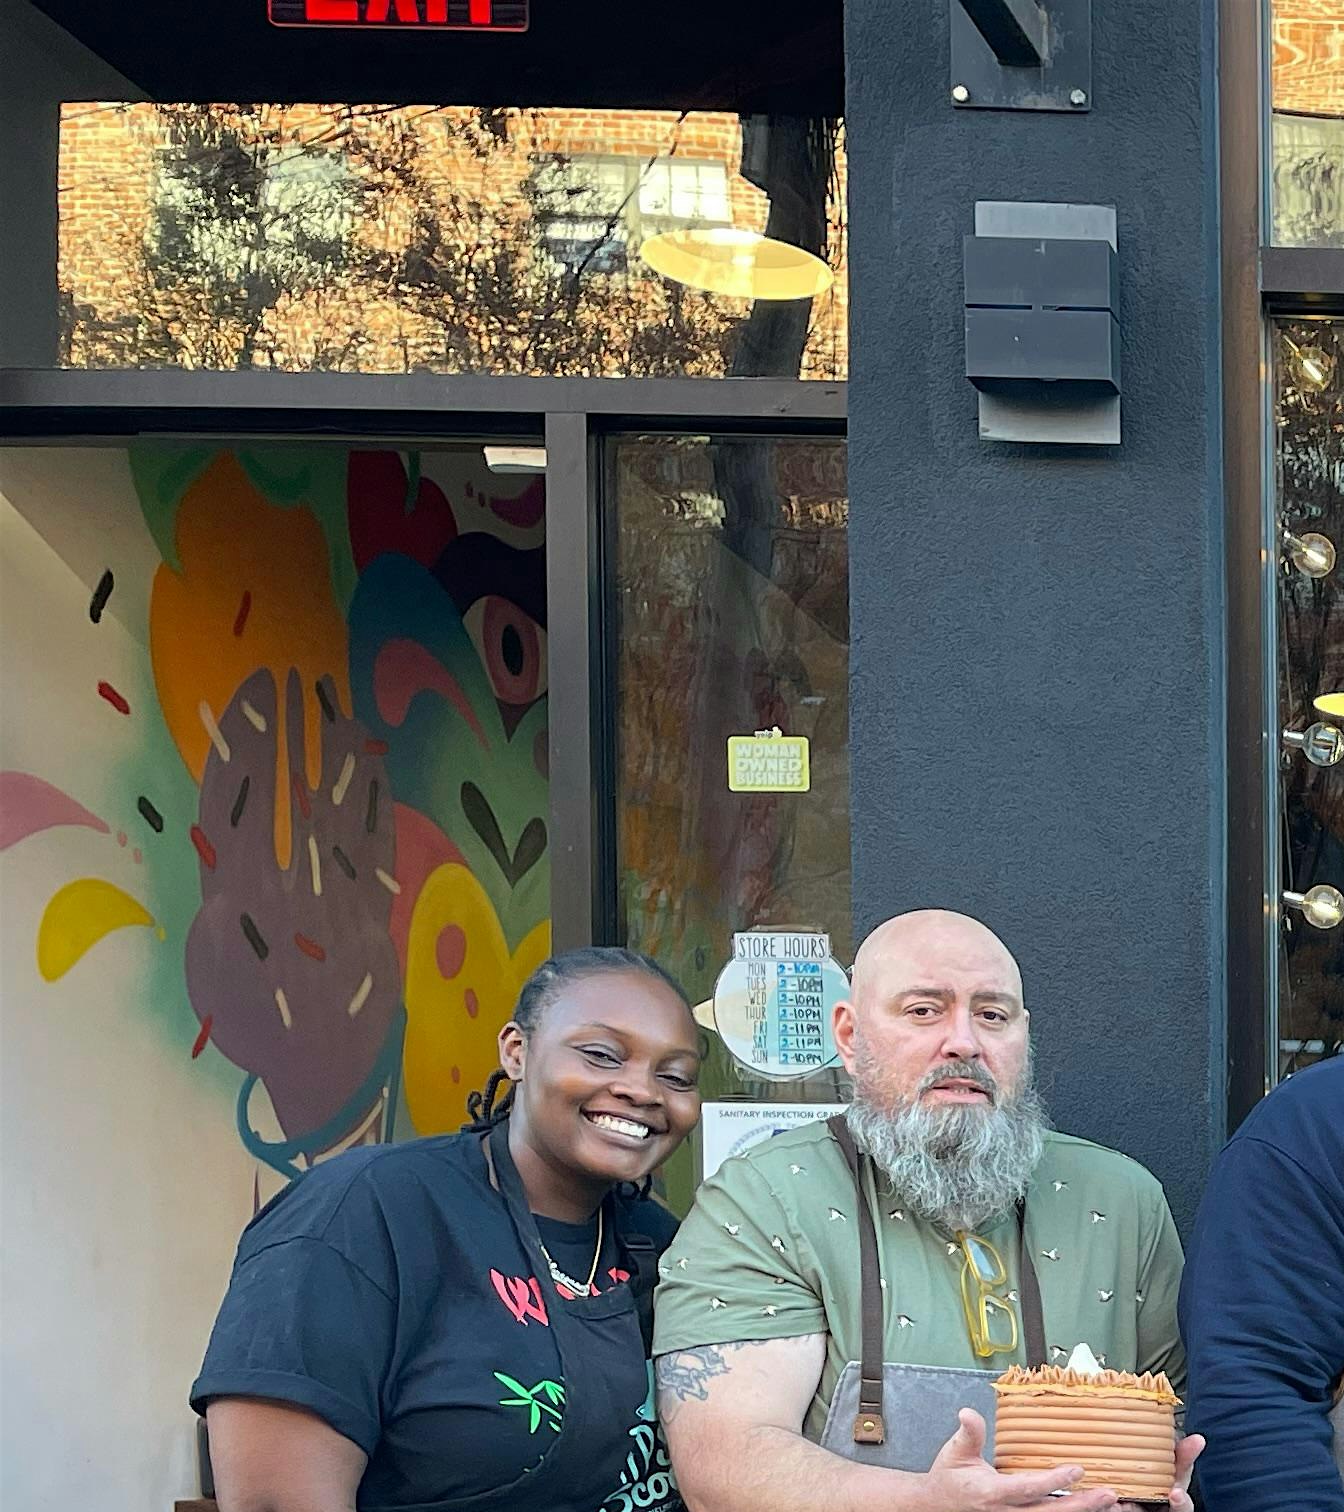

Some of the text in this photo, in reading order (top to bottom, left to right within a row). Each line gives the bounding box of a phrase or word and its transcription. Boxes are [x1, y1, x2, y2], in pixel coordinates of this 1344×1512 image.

[735, 744, 802, 758] WOMAN
[735, 759, 804, 772] OWNED
[735, 772, 804, 786] BUSINESS
[739, 937, 826, 959] STORE HOURS
[747, 962, 766, 976] MON
[746, 977, 767, 991] TUES
[748, 992, 767, 1005] WED
[745, 1006, 767, 1020] THUR
[753, 1021, 767, 1034] FRI
[753, 1036, 768, 1049] SAT
[752, 1050, 768, 1063] SUN
[719, 1110, 842, 1119] SANITARY INSPECTION GRA
